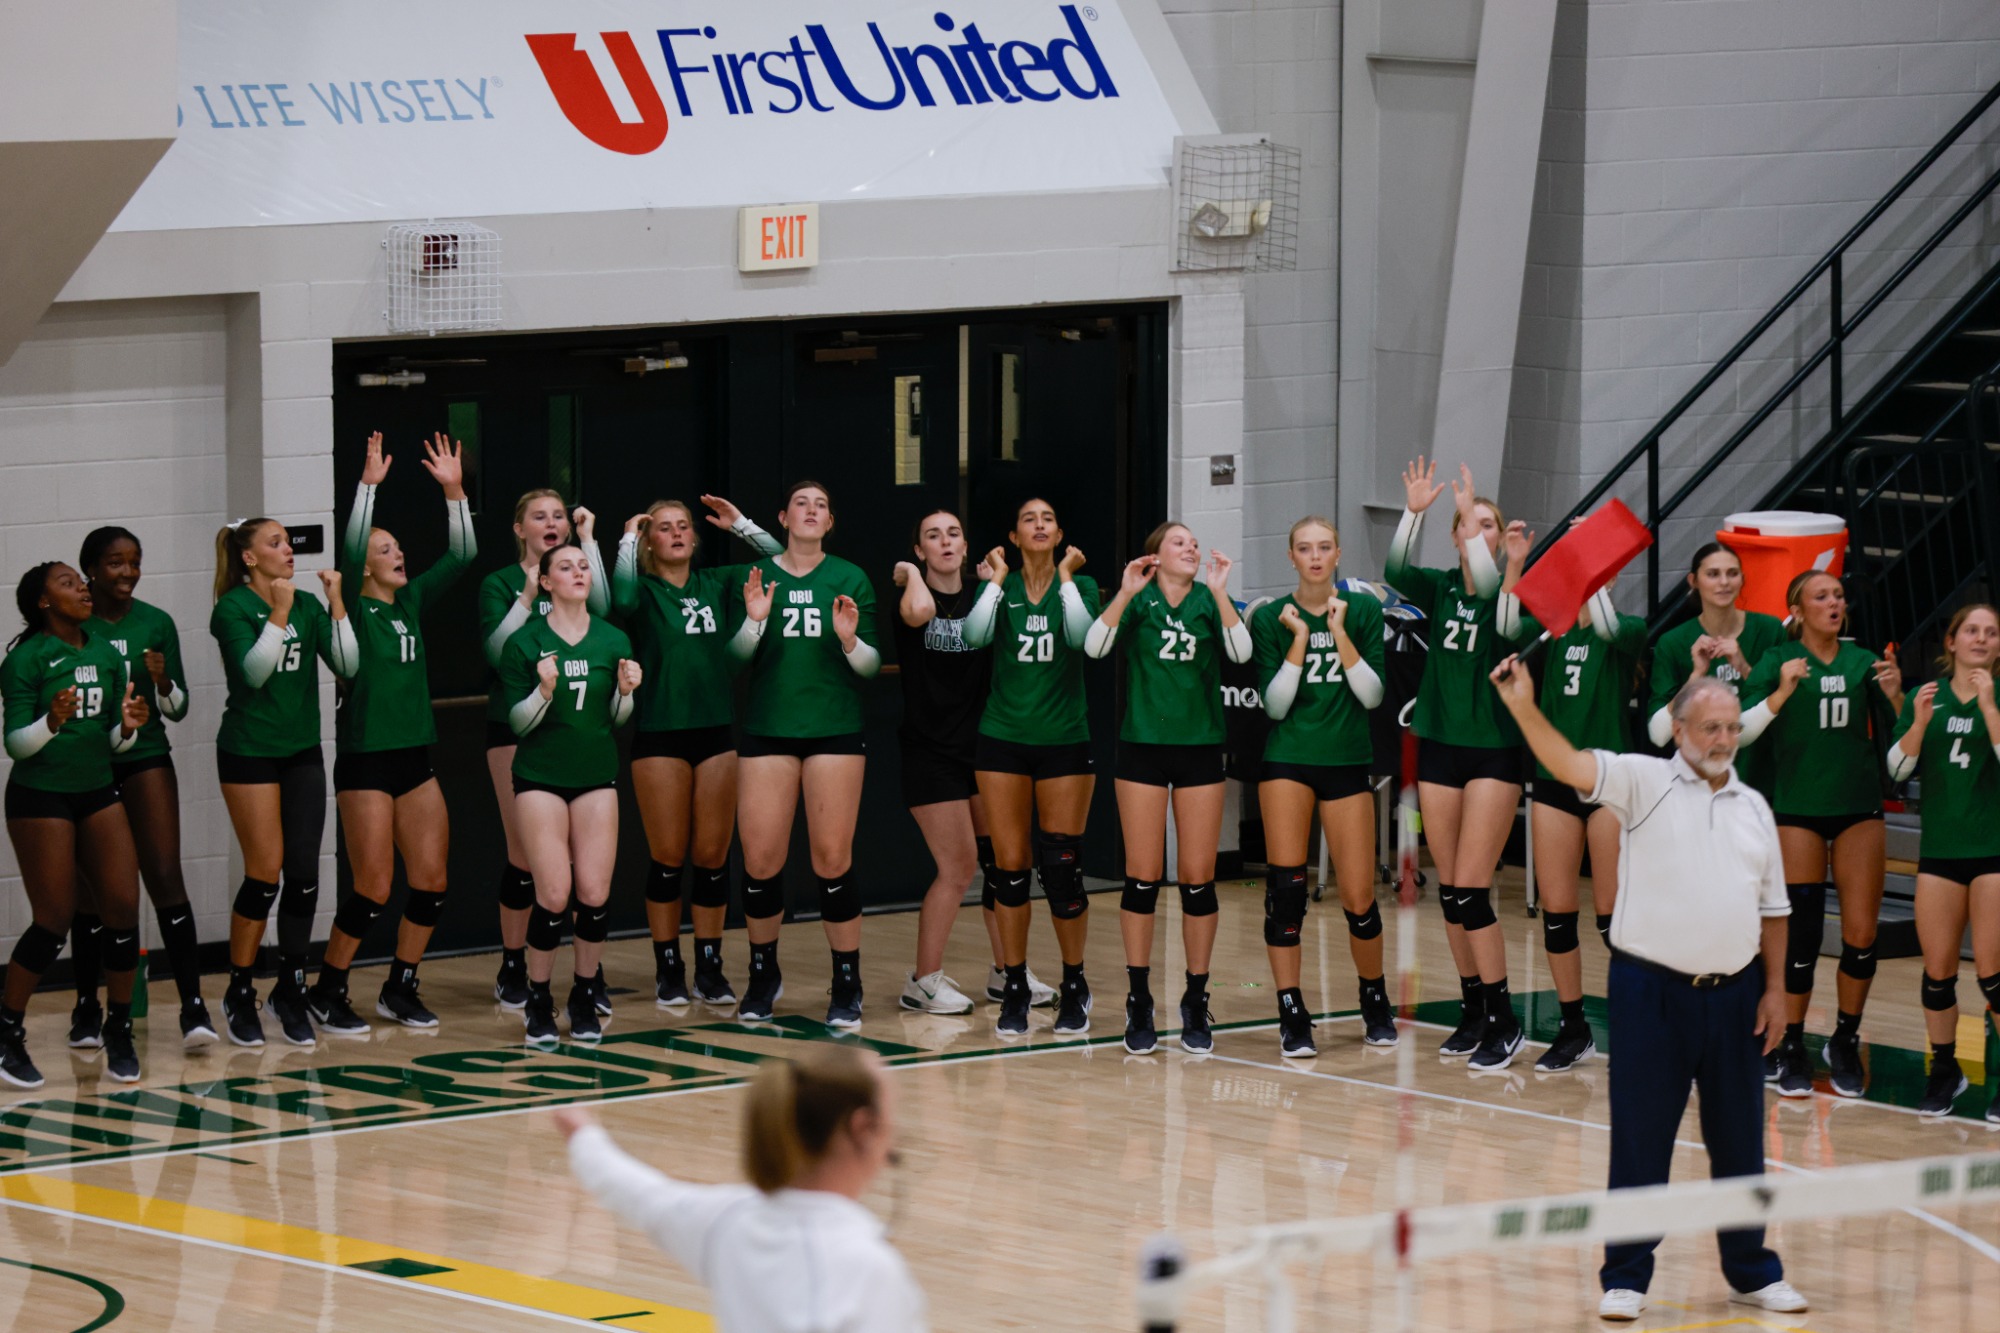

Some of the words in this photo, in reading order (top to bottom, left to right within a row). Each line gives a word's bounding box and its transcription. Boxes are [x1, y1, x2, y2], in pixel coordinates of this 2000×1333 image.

[192, 83, 306, 129] LIFE
[761, 215, 807, 260] EXIT
[292, 536, 306, 544] EXIT
[788, 589, 813, 604] OBU
[681, 605, 717, 634] 28
[782, 607, 822, 638] 26
[1025, 614, 1048, 632] OBU
[400, 634, 416, 663] 11
[1017, 632, 1054, 663] 20
[1159, 629, 1197, 661] 23
[1310, 631, 1334, 648] OBU
[1443, 619, 1479, 652] 27
[277, 642, 301, 672] 15
[564, 659, 589, 677] OBU
[1305, 652, 1342, 683] 22
[1565, 644, 1589, 662] OBU
[74, 665, 99, 683] OBU
[1564, 664, 1581, 696] 3
[1820, 675, 1846, 694] OBU
[75, 687, 103, 718] 19
[568, 680, 588, 711] 7
[1819, 697, 1849, 729] 10
[1946, 715, 1974, 734] OBU
[1949, 737, 1971, 769] 4
